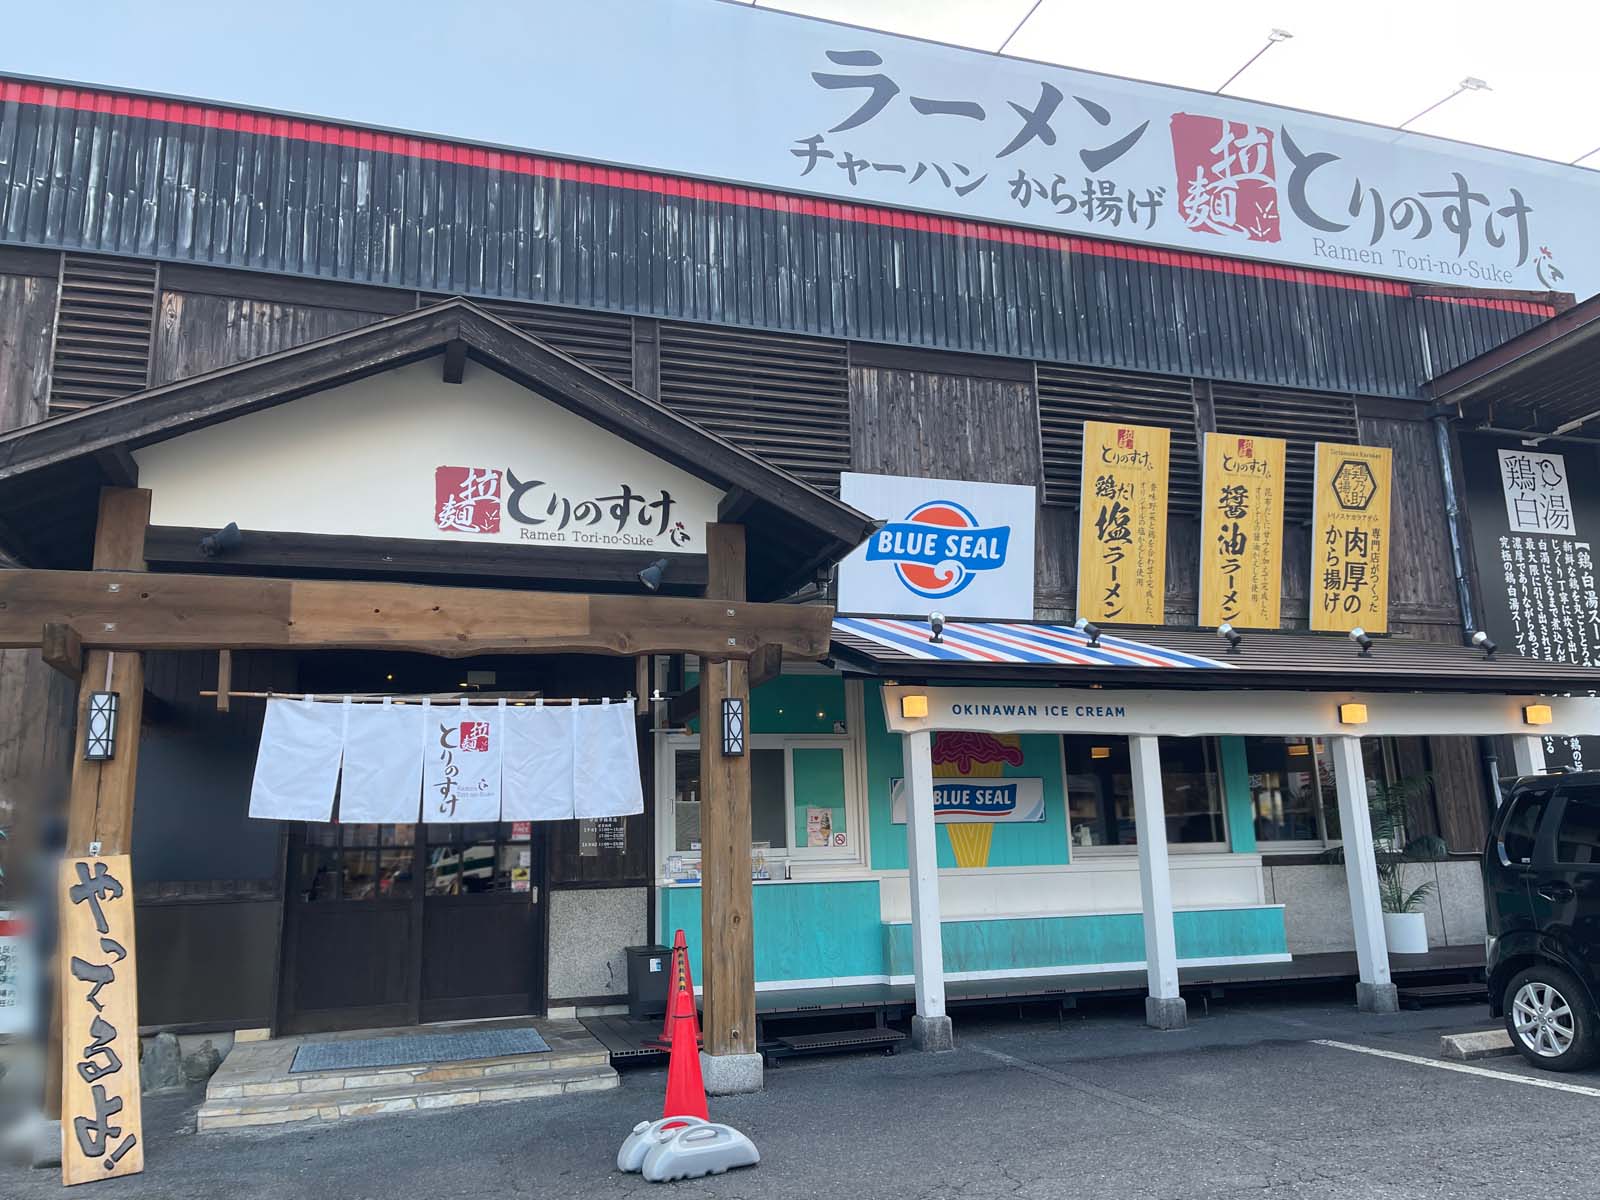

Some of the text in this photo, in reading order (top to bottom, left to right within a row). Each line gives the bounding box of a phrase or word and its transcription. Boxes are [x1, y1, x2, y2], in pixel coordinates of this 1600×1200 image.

[811, 50, 1150, 173] ラーメン
[790, 133, 1167, 231] チャーハン から揚げ
[1279, 123, 1535, 268] とりのすけ
[1312, 237, 1514, 284] Ramen Tori-no-Suke
[1101, 444, 1150, 467] とりのすけ
[1223, 453, 1268, 476] とりのすけ
[1503, 455, 1537, 492] 鶏
[505, 466, 678, 537] とりのすけ
[519, 527, 654, 546] Ramen Tori-no-Suke
[1512, 492, 1570, 531] 白湯
[878, 531, 1001, 560] BLUE SEAL
[1094, 501, 1133, 620] 塩ラーメン
[1322, 525, 1343, 614] から揚げ
[1342, 527, 1369, 614] 肉厚の
[1368, 527, 1381, 613] 専門店がつくった
[951, 703, 1126, 718] OKINAWAN ICE CREAM
[433, 722, 460, 817] とりのすけ
[934, 789, 1012, 806] BLUE SEAL
[69, 861, 137, 1170] やってるよ!
